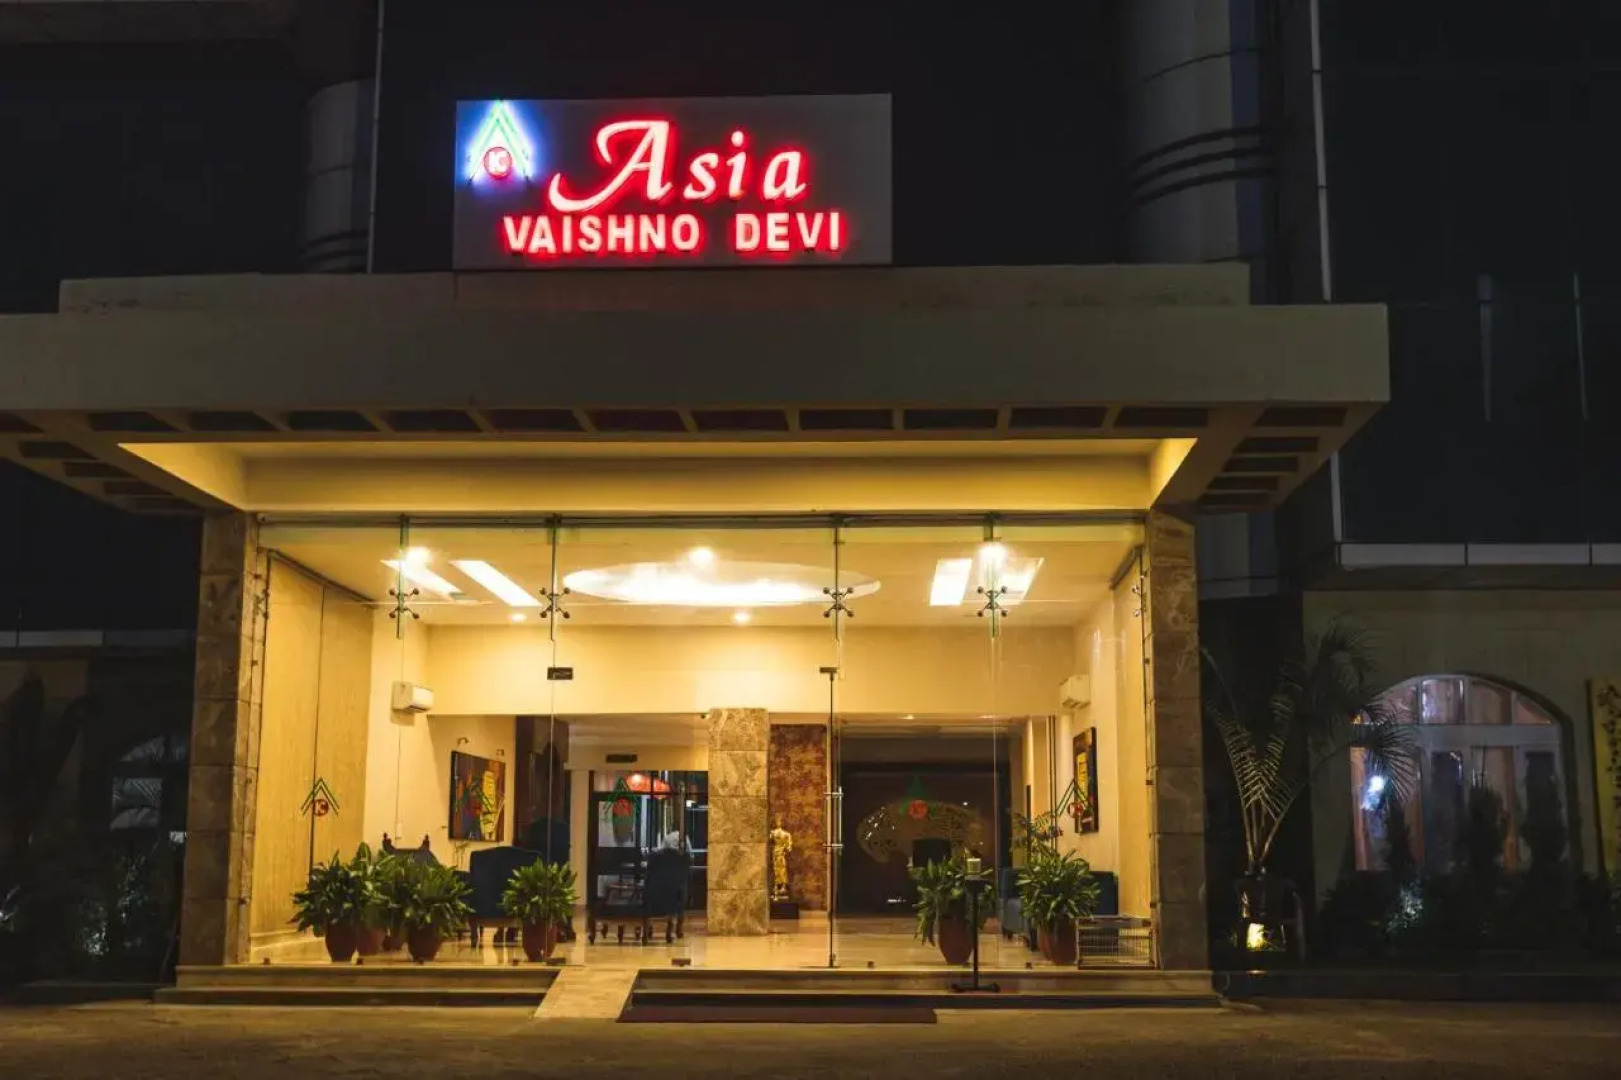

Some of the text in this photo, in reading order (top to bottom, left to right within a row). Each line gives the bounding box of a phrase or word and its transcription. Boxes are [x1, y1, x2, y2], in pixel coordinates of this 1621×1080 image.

[548, 119, 807, 212] Asia
[503, 212, 841, 254] VAISHNO DEVI
